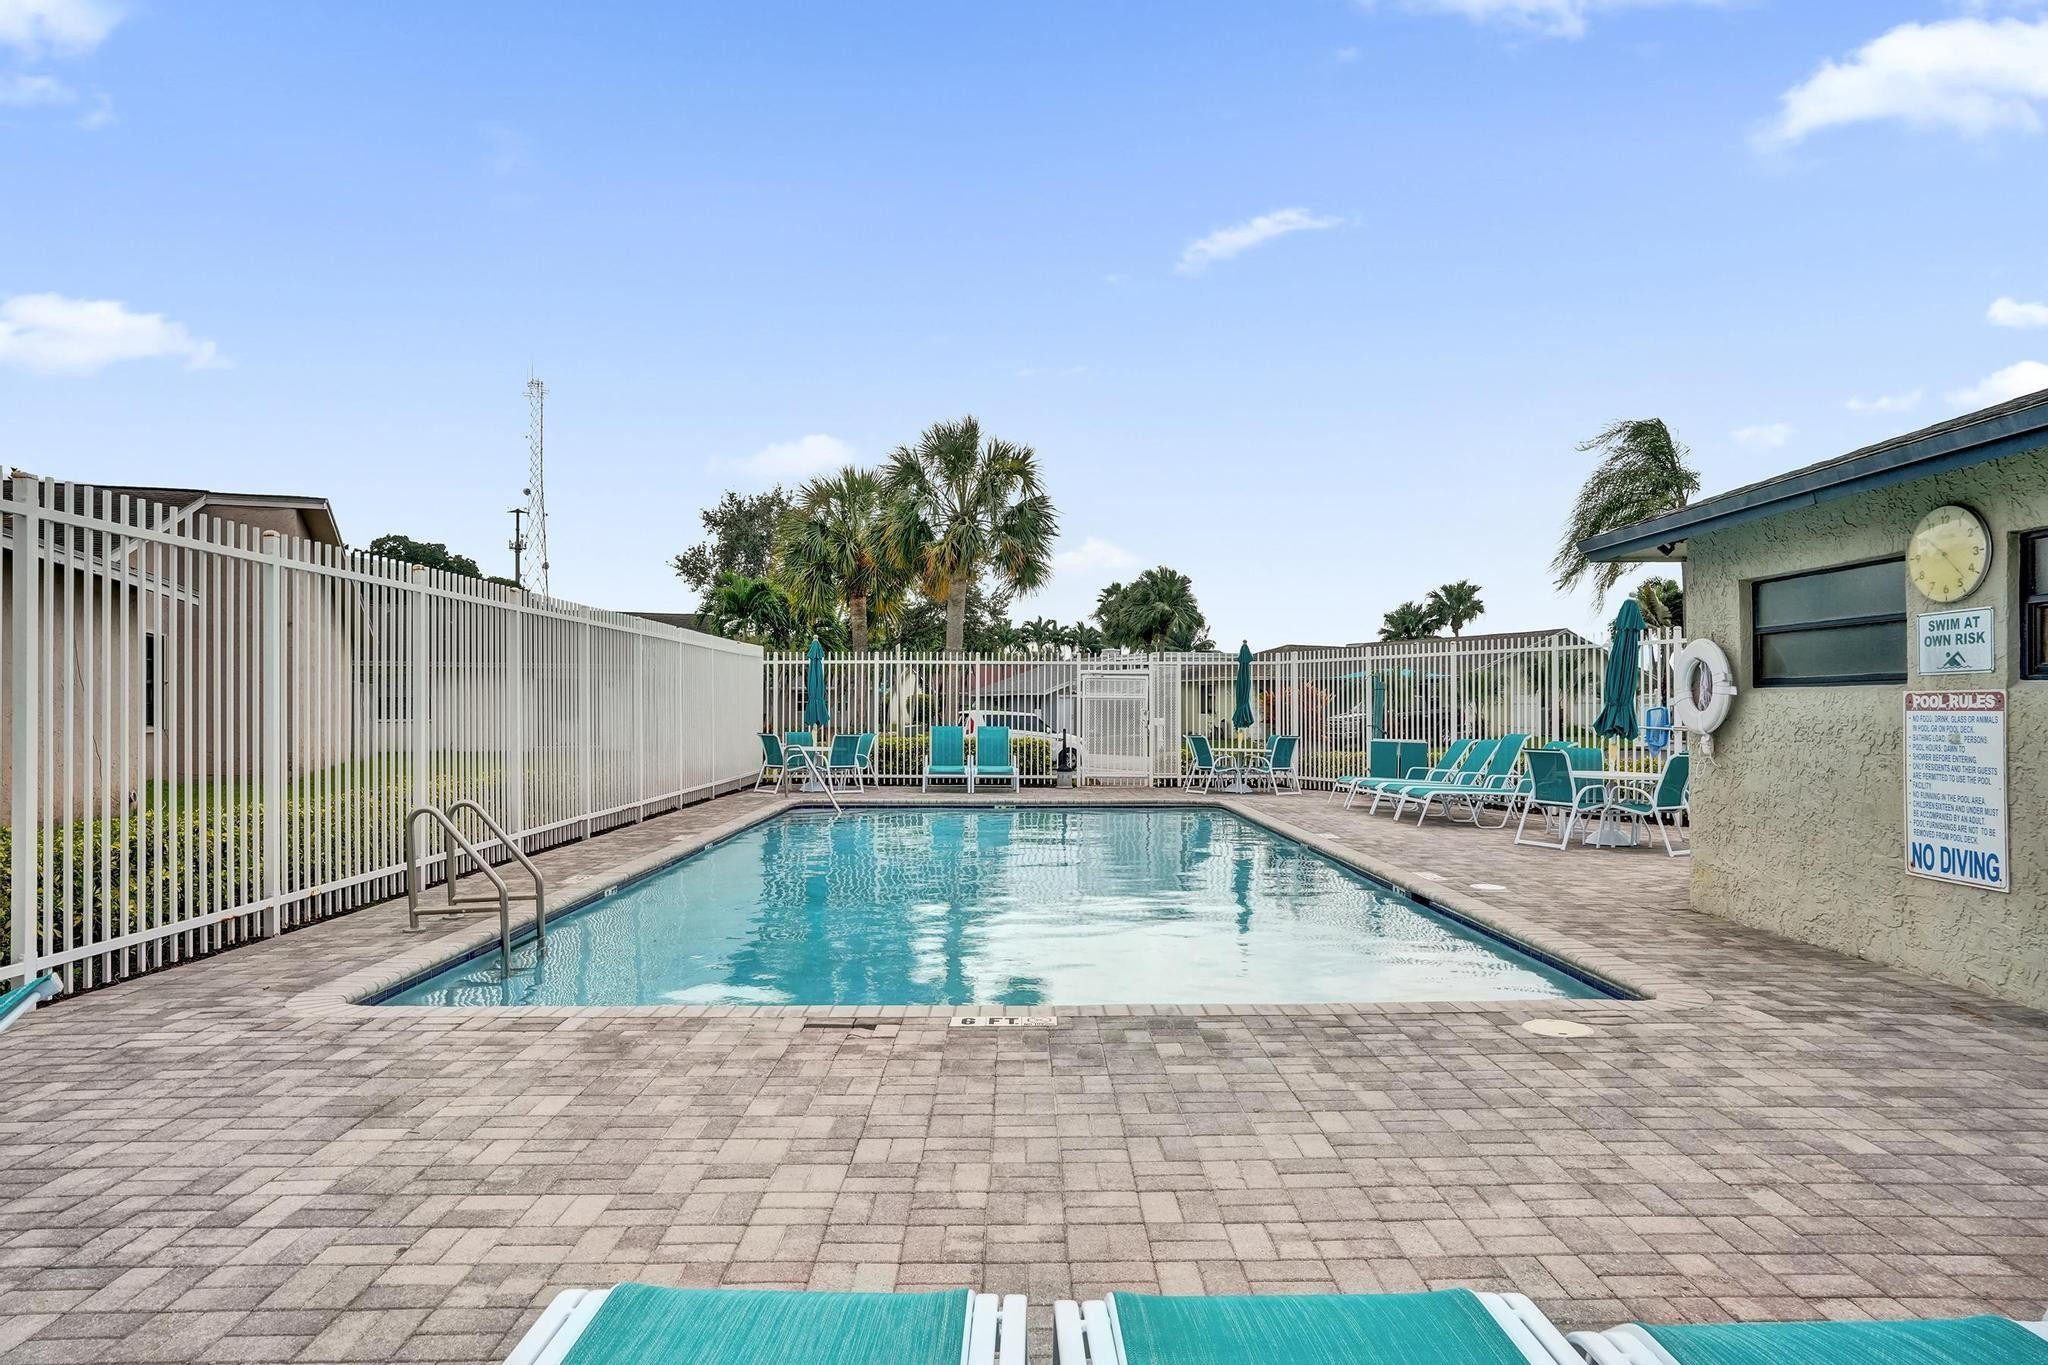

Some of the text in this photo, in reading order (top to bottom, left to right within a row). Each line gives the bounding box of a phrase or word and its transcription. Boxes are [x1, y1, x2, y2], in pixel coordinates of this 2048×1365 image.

[1972, 546, 1980, 556] 3
[1928, 616, 1980, 632] SWIM AT
[1924, 632, 1985, 647] OWN RISK
[1912, 691, 1997, 710] POOL RULES
[1933, 754, 1951, 762] BEFORE
[1952, 755, 1976, 764] ENTERING
[1925, 763, 1950, 772] RESIDENTS
[1962, 766, 1976, 774] THEIR
[1977, 767, 1998, 775] GUESTS
[1923, 773, 1948, 781] PERMITTED
[1912, 842, 2000, 882] NO DIVING
